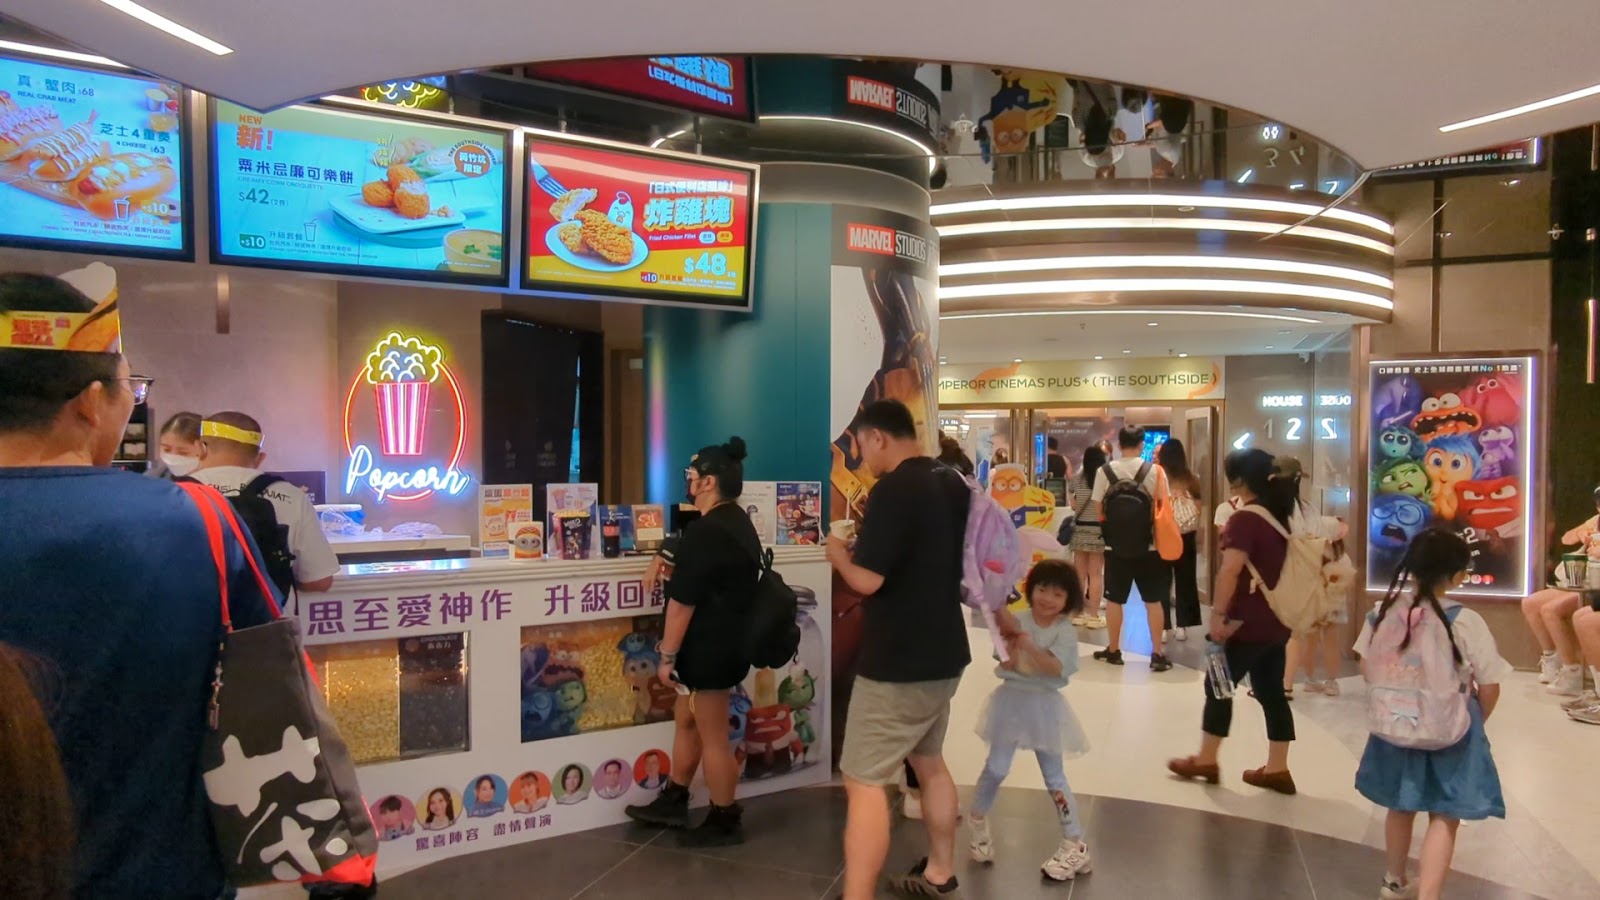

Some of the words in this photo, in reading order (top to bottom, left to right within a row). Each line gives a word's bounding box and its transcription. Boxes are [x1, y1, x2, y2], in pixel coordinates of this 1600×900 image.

[239, 114, 263, 125] NEW
[239, 187, 270, 204] $42
[850, 226, 895, 252] MARVEL
[895, 234, 926, 261] STUDIOS
[684, 251, 727, 276] $48
[988, 377, 1045, 389] CINEMAS
[1048, 376, 1089, 388] PLUS+
[1128, 373, 1209, 386] SOUTHSIDE
[1262, 395, 1303, 407] HOUSE
[1263, 419, 1273, 439] 1
[1286, 417, 1302, 440] 2
[345, 444, 468, 502] Popcorn
[307, 589, 513, 636] 思至愛神作
